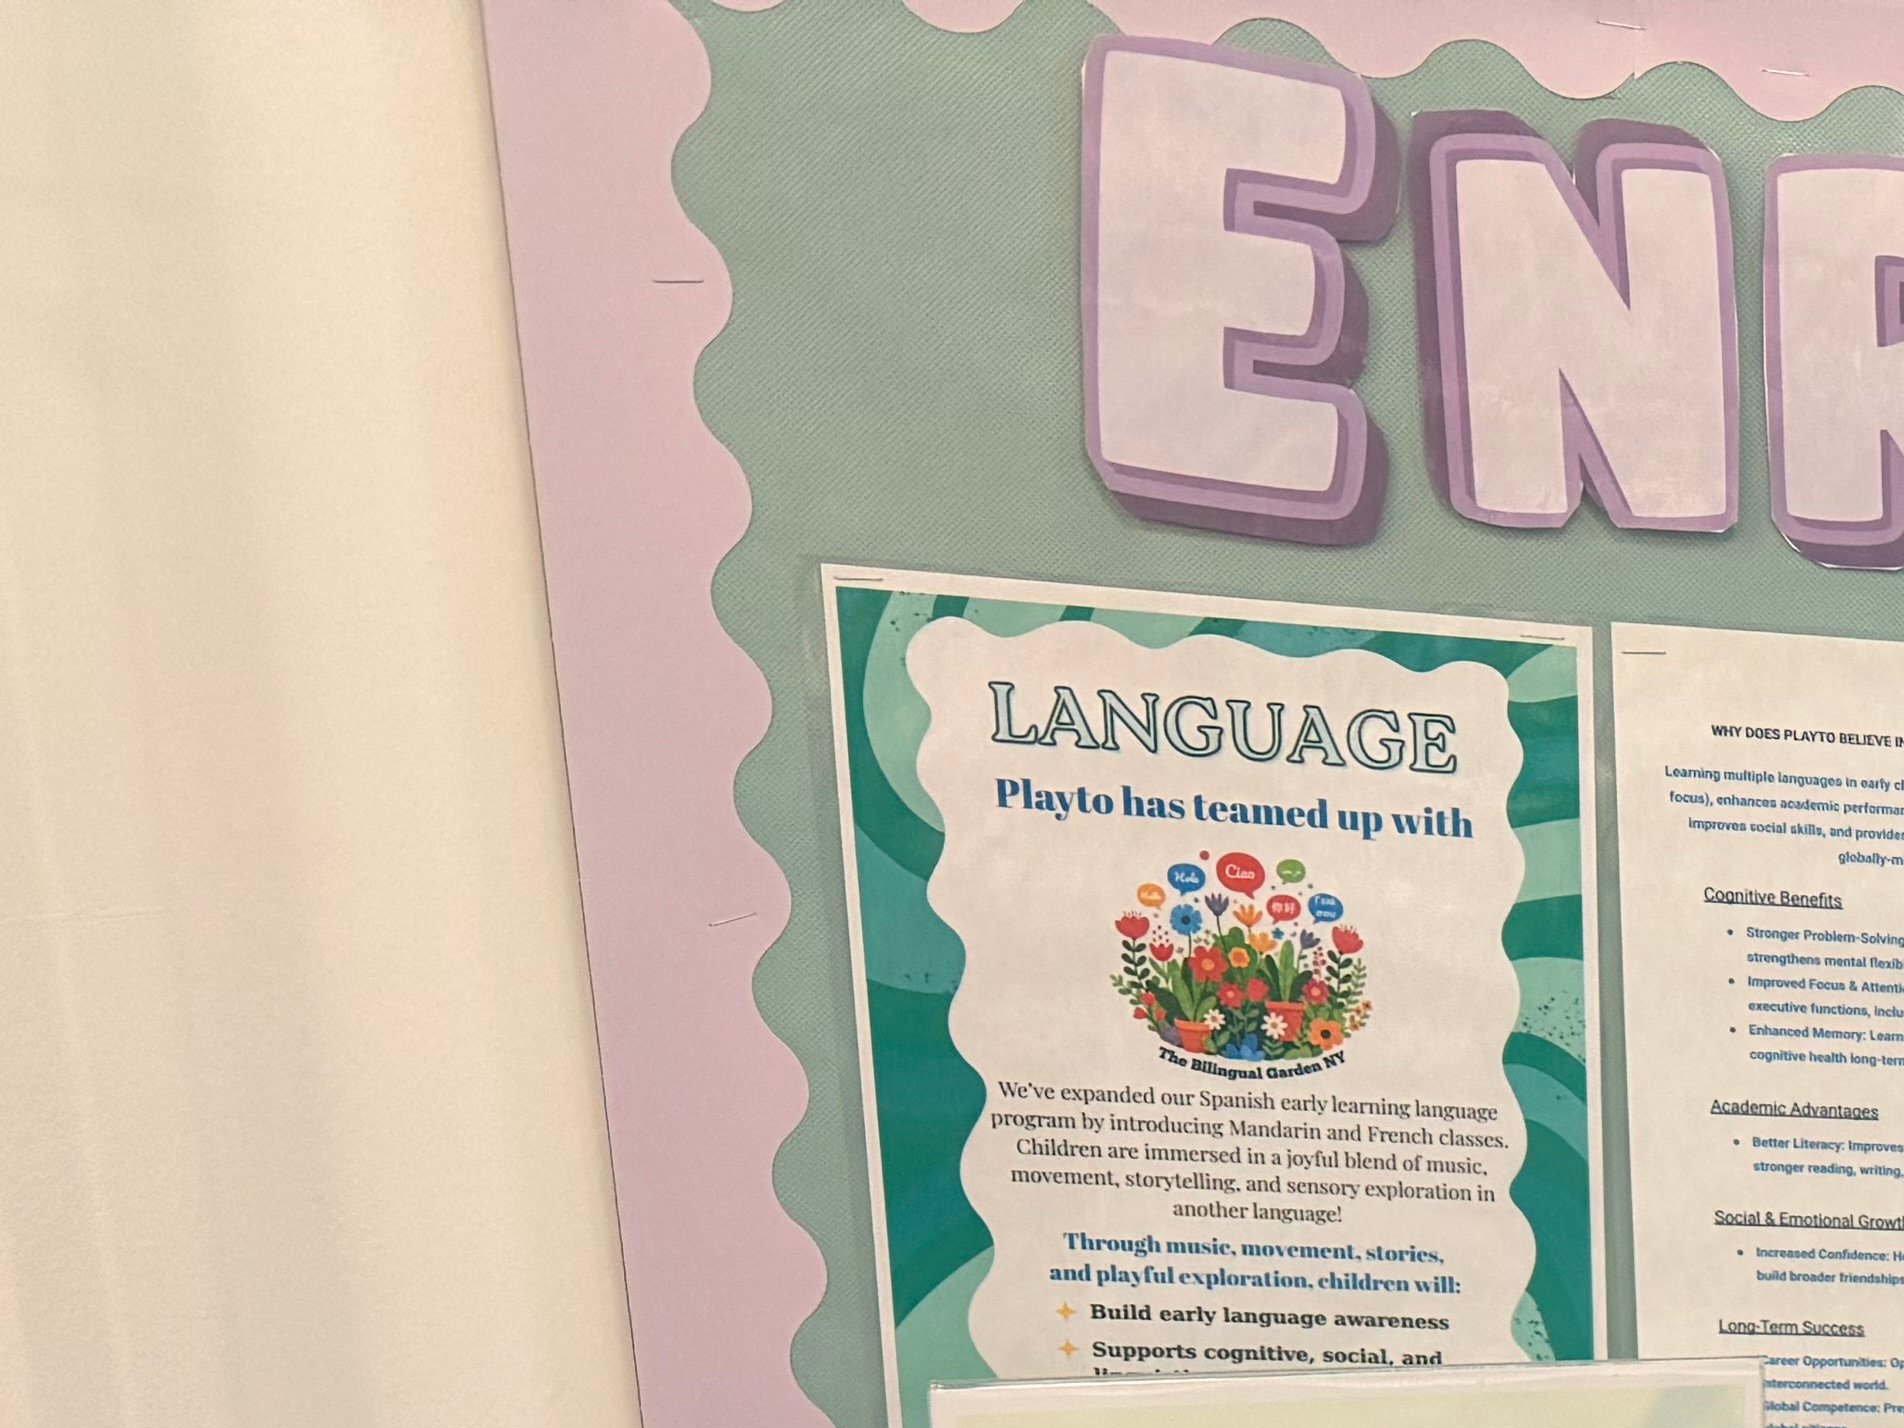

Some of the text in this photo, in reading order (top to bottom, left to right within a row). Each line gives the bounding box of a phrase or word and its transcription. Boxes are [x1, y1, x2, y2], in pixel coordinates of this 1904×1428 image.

[988, 680, 1459, 775] LANGUAGE
[1710, 724, 1743, 738] WHY
[1745, 726, 1781, 741] DOES
[1783, 728, 1836, 744] PLAYTO
[1839, 732, 1892, 748] BELIEVE
[995, 778, 1473, 841] Playto has teamed up with
[1704, 886, 1843, 909] Cognitive Benefits
[1746, 926, 1801, 943] Stronger
[1159, 1046, 1346, 1081] The Bilingual Garden NY
[997, 1080, 1498, 1124] We've expanded our Spanish early learning language
[1710, 1100, 1879, 1121] Academic Advantages
[1172, 1200, 1343, 1226] another language!
[1714, 1210, 1761, 1228] Social
[1764, 1211, 1777, 1228] &
[1779, 1212, 1854, 1230] Emotional
[1062, 1231, 1445, 1264] Through music, movement, stories,
[1089, 1303, 1450, 1331] Build early language awareness
[1718, 1318, 1865, 1338] Long-Term Success
[1092, 1341, 1443, 1369] Supports cognitive, social, and
